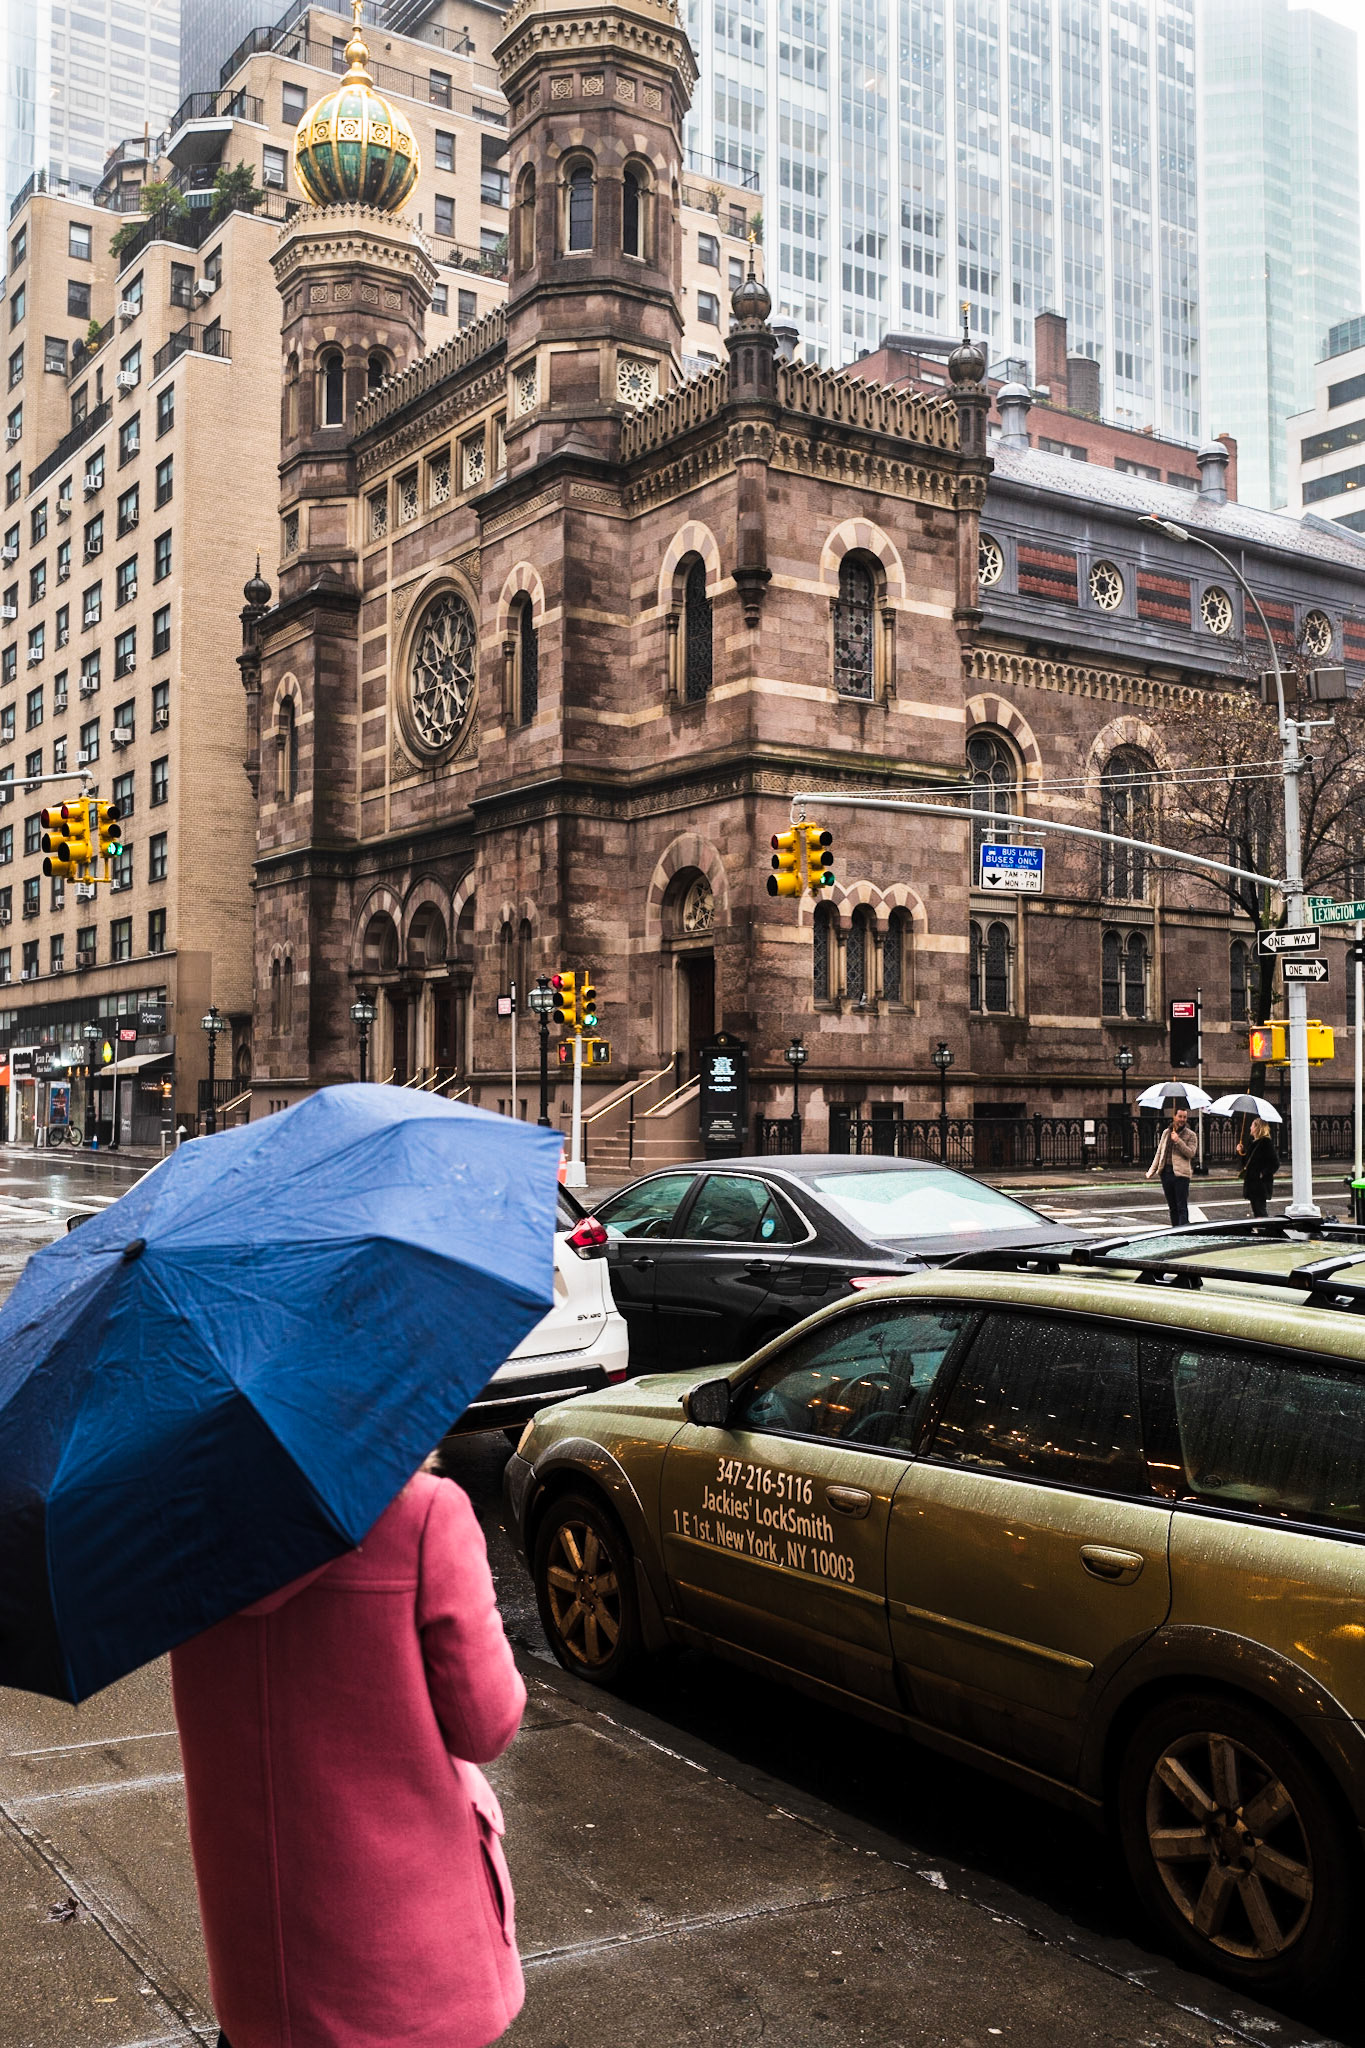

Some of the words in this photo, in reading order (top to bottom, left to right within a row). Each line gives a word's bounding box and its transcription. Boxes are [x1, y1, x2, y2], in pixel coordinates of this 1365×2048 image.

[1002, 848, 1016, 856] BUS
[985, 855, 1014, 864] BUSES
[1017, 857, 1039, 866] ONLY
[1309, 898, 1313, 906] E
[1313, 904, 1355, 922] LEXINGTON
[1268, 936, 1286, 947] ONE
[1294, 935, 1312, 945] WAY
[1289, 966, 1303, 975] ONE
[1308, 966, 1322, 975] WAY
[716, 1457, 813, 1505] 347-216-5116
[702, 1485, 753, 1521] Jackies'
[755, 1499, 834, 1543] LockSmith
[673, 1509, 680, 1533] 1
[682, 1511, 690, 1536] E
[692, 1514, 714, 1543] 1st.
[716, 1520, 744, 1551] New
[746, 1528, 778, 1562] York
[787, 1540, 807, 1570] NY
[811, 1547, 856, 1584] 10003
